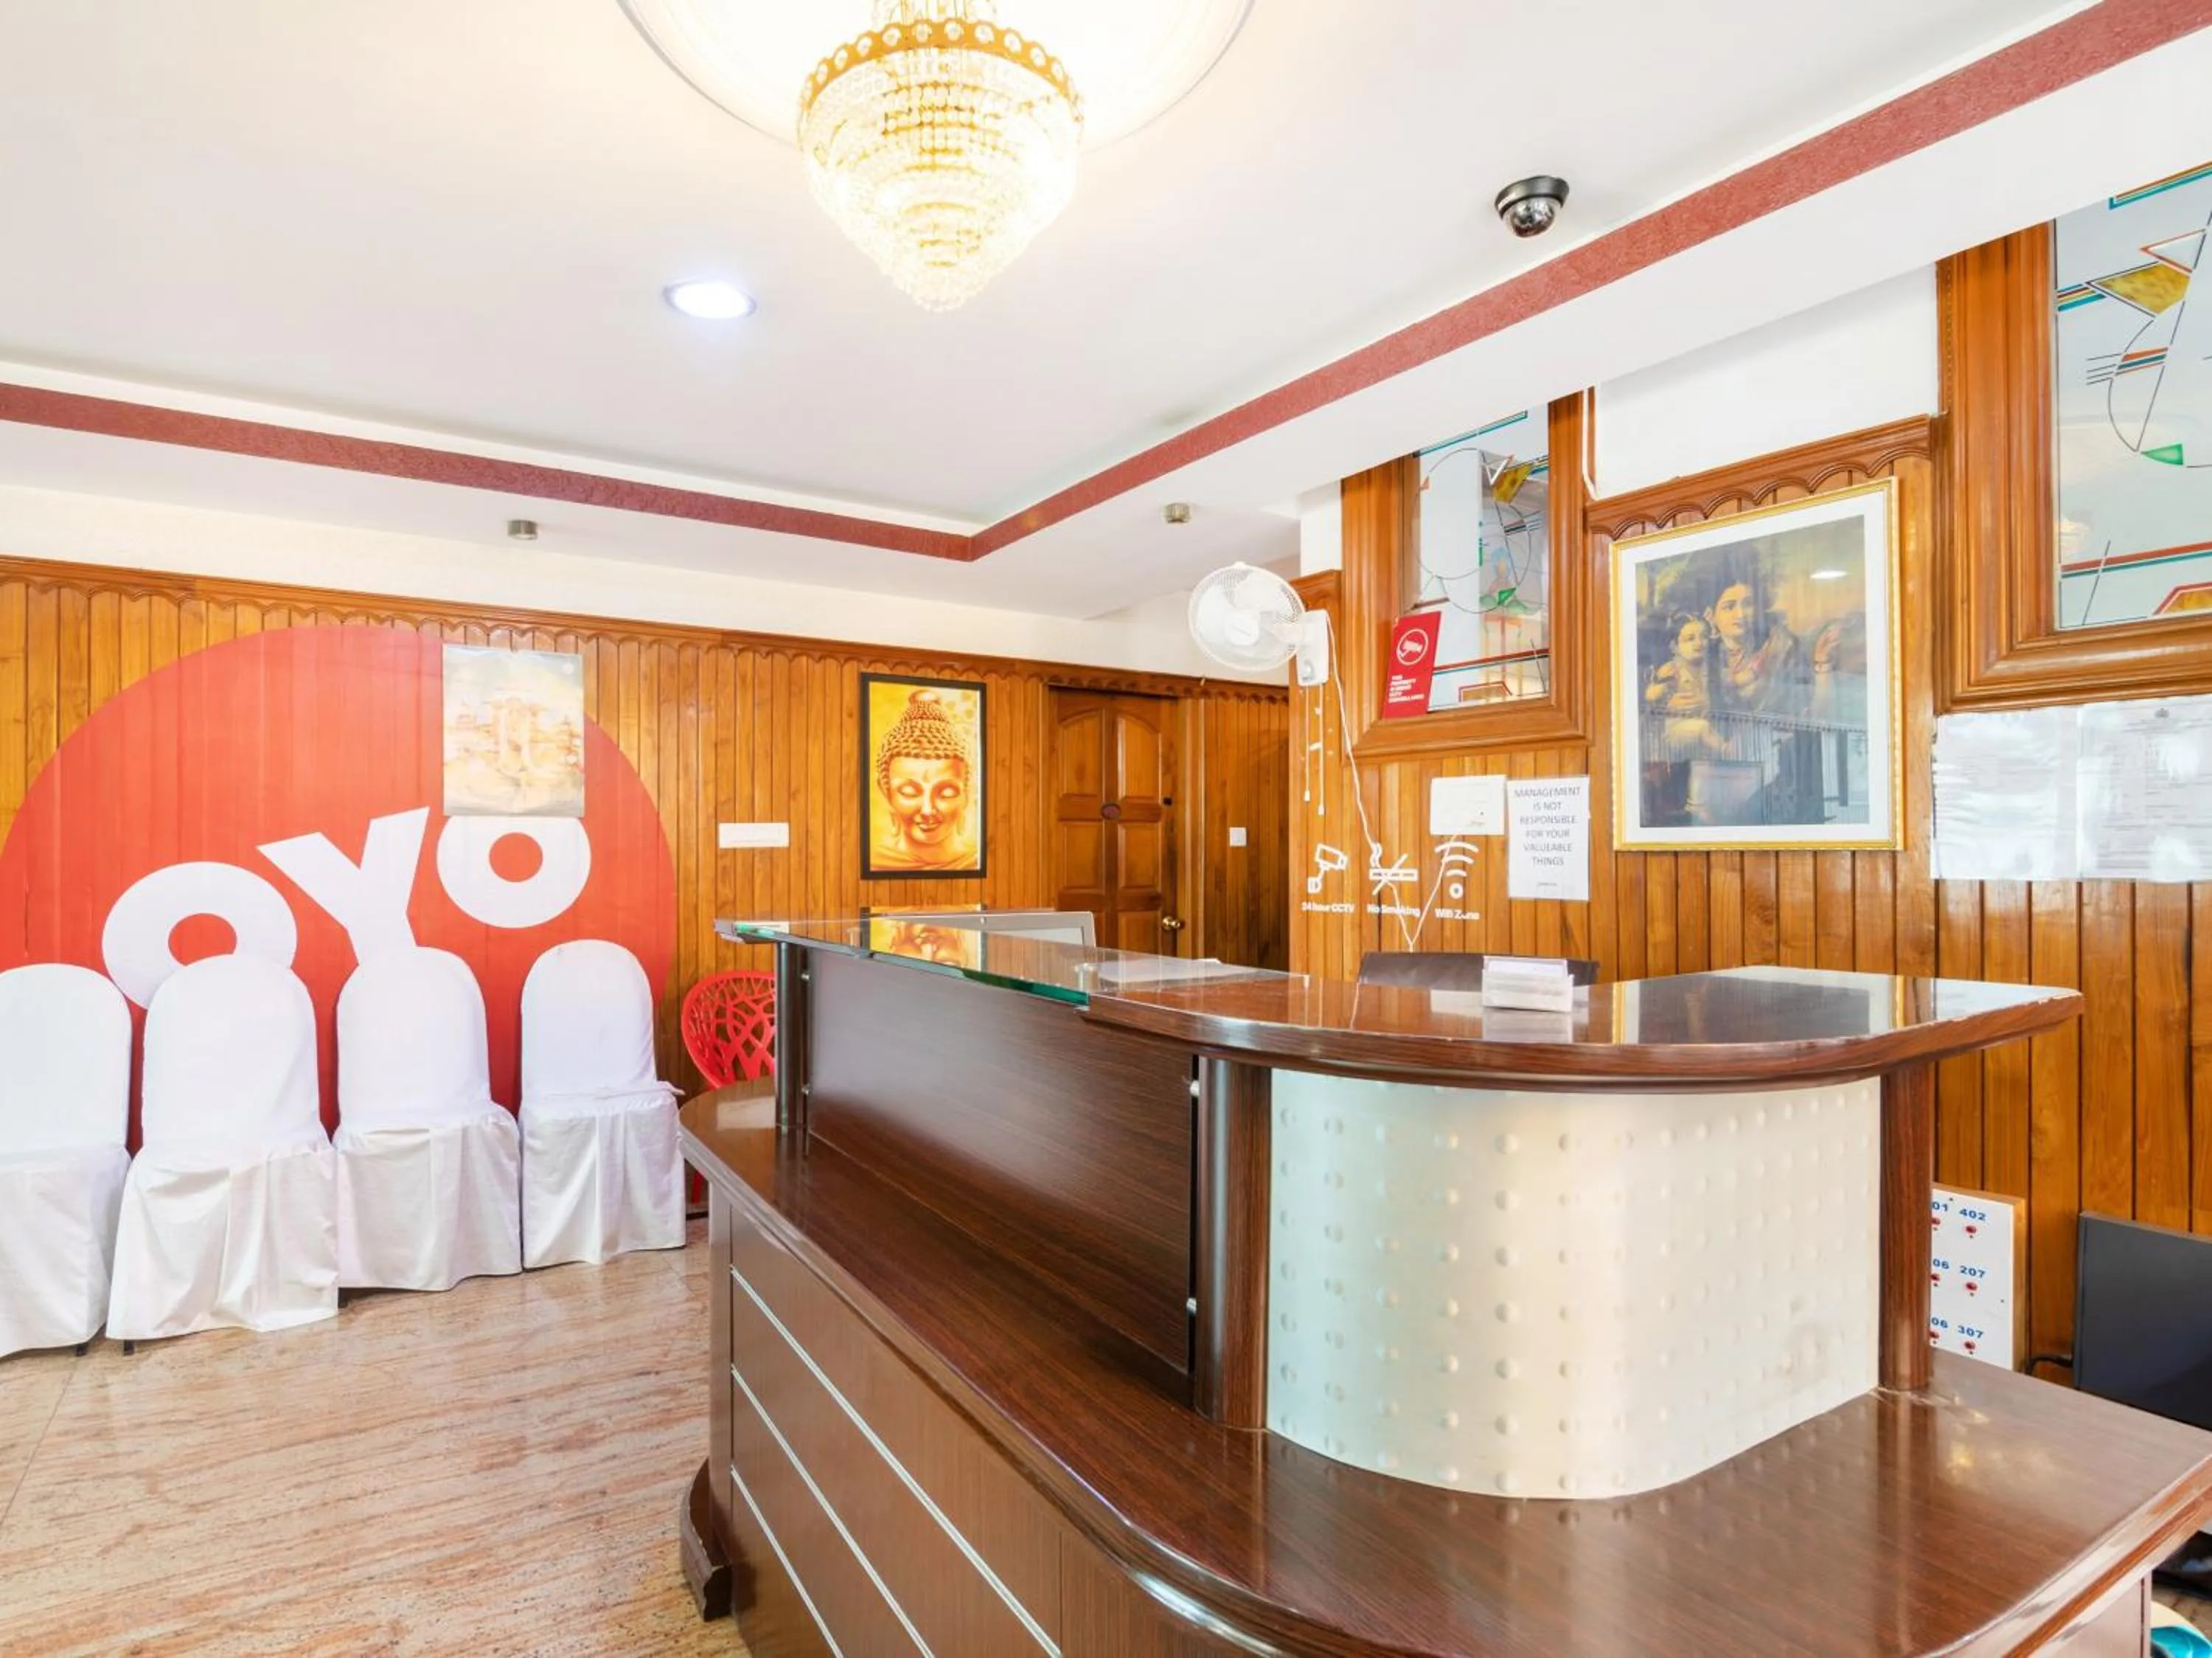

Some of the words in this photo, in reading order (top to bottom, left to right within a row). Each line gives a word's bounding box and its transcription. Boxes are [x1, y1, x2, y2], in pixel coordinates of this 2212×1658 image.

[1514, 786, 1581, 797] MANAGEMENT
[1533, 802, 1541, 811] IS
[1543, 802, 1562, 811] NOT
[1520, 815, 1578, 825] RESPONSIBLE
[1526, 830, 1544, 839] FOR
[1545, 829, 1570, 839] YOUR
[1523, 842, 1573, 852] VALUEABLE
[1532, 856, 1565, 866] THINGS
[1932, 1201, 1949, 1212] 01
[1959, 1209, 1986, 1221] 402
[1933, 1258, 1950, 1269] 06
[1959, 1265, 1985, 1278] 207
[1931, 1317, 1948, 1328] 06
[1958, 1325, 1983, 1338] 307
